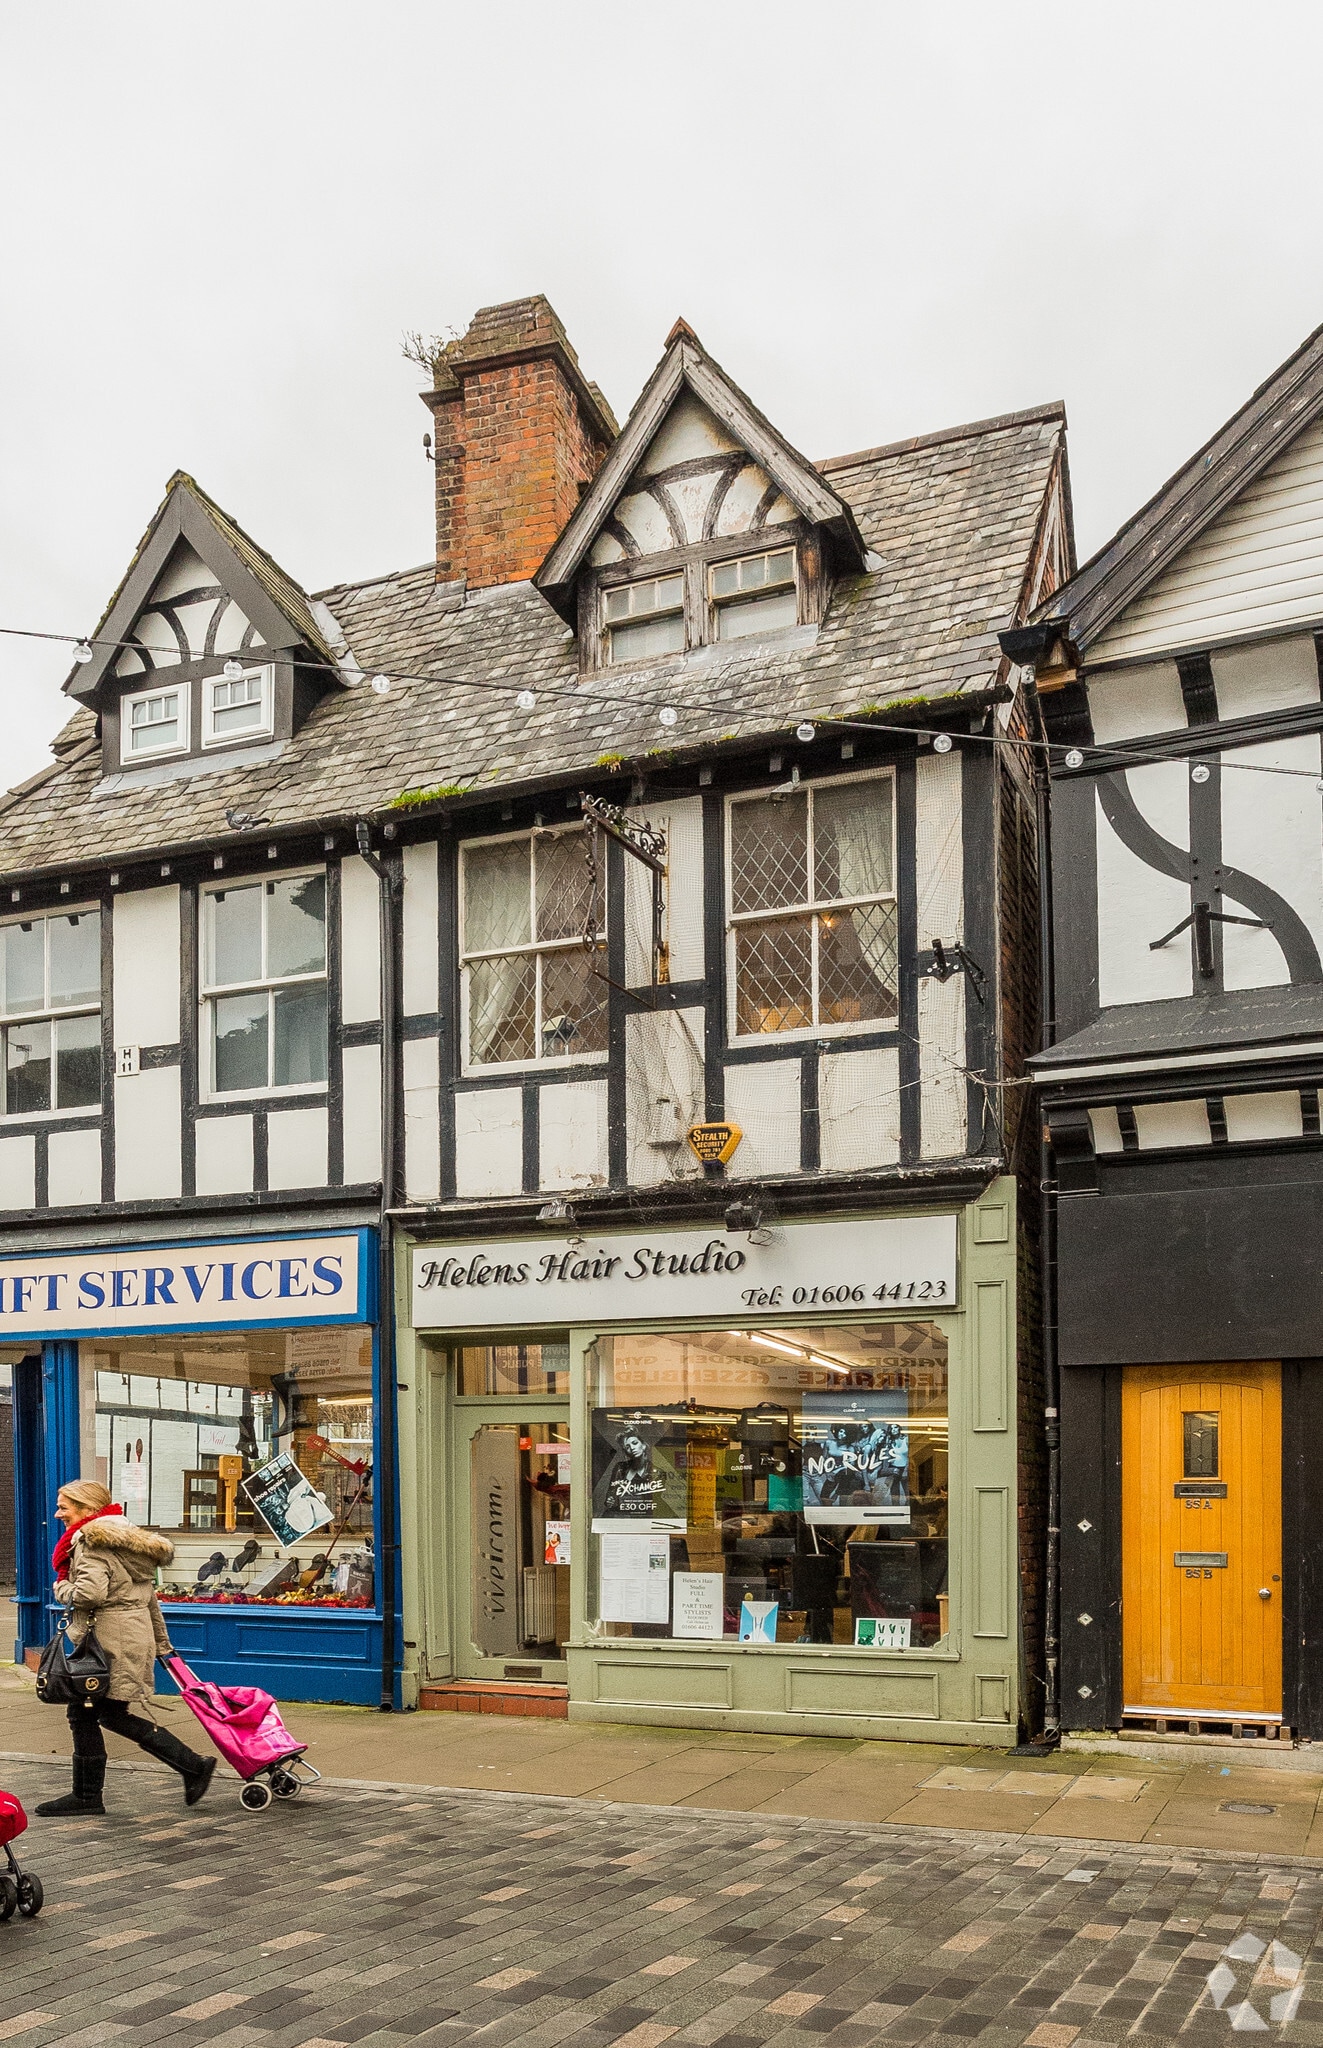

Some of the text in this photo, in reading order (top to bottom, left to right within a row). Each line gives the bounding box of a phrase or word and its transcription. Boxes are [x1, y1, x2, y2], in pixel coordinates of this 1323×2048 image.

[123, 1048, 132, 1060] H
[121, 1062, 132, 1073] 11
[418, 1239, 746, 1289] Helens Hair Studio
[78, 1255, 343, 1310] SERVICES
[740, 1280, 947, 1307] Tel: 01606 44123
[841, 1447, 903, 1473] RULES
[253, 1478, 287, 1503] shoe repairs
[615, 1480, 664, 1498] EXCHANGE
[620, 1502, 658, 1511] £30 OFF
[1202, 1498, 1213, 1510] A
